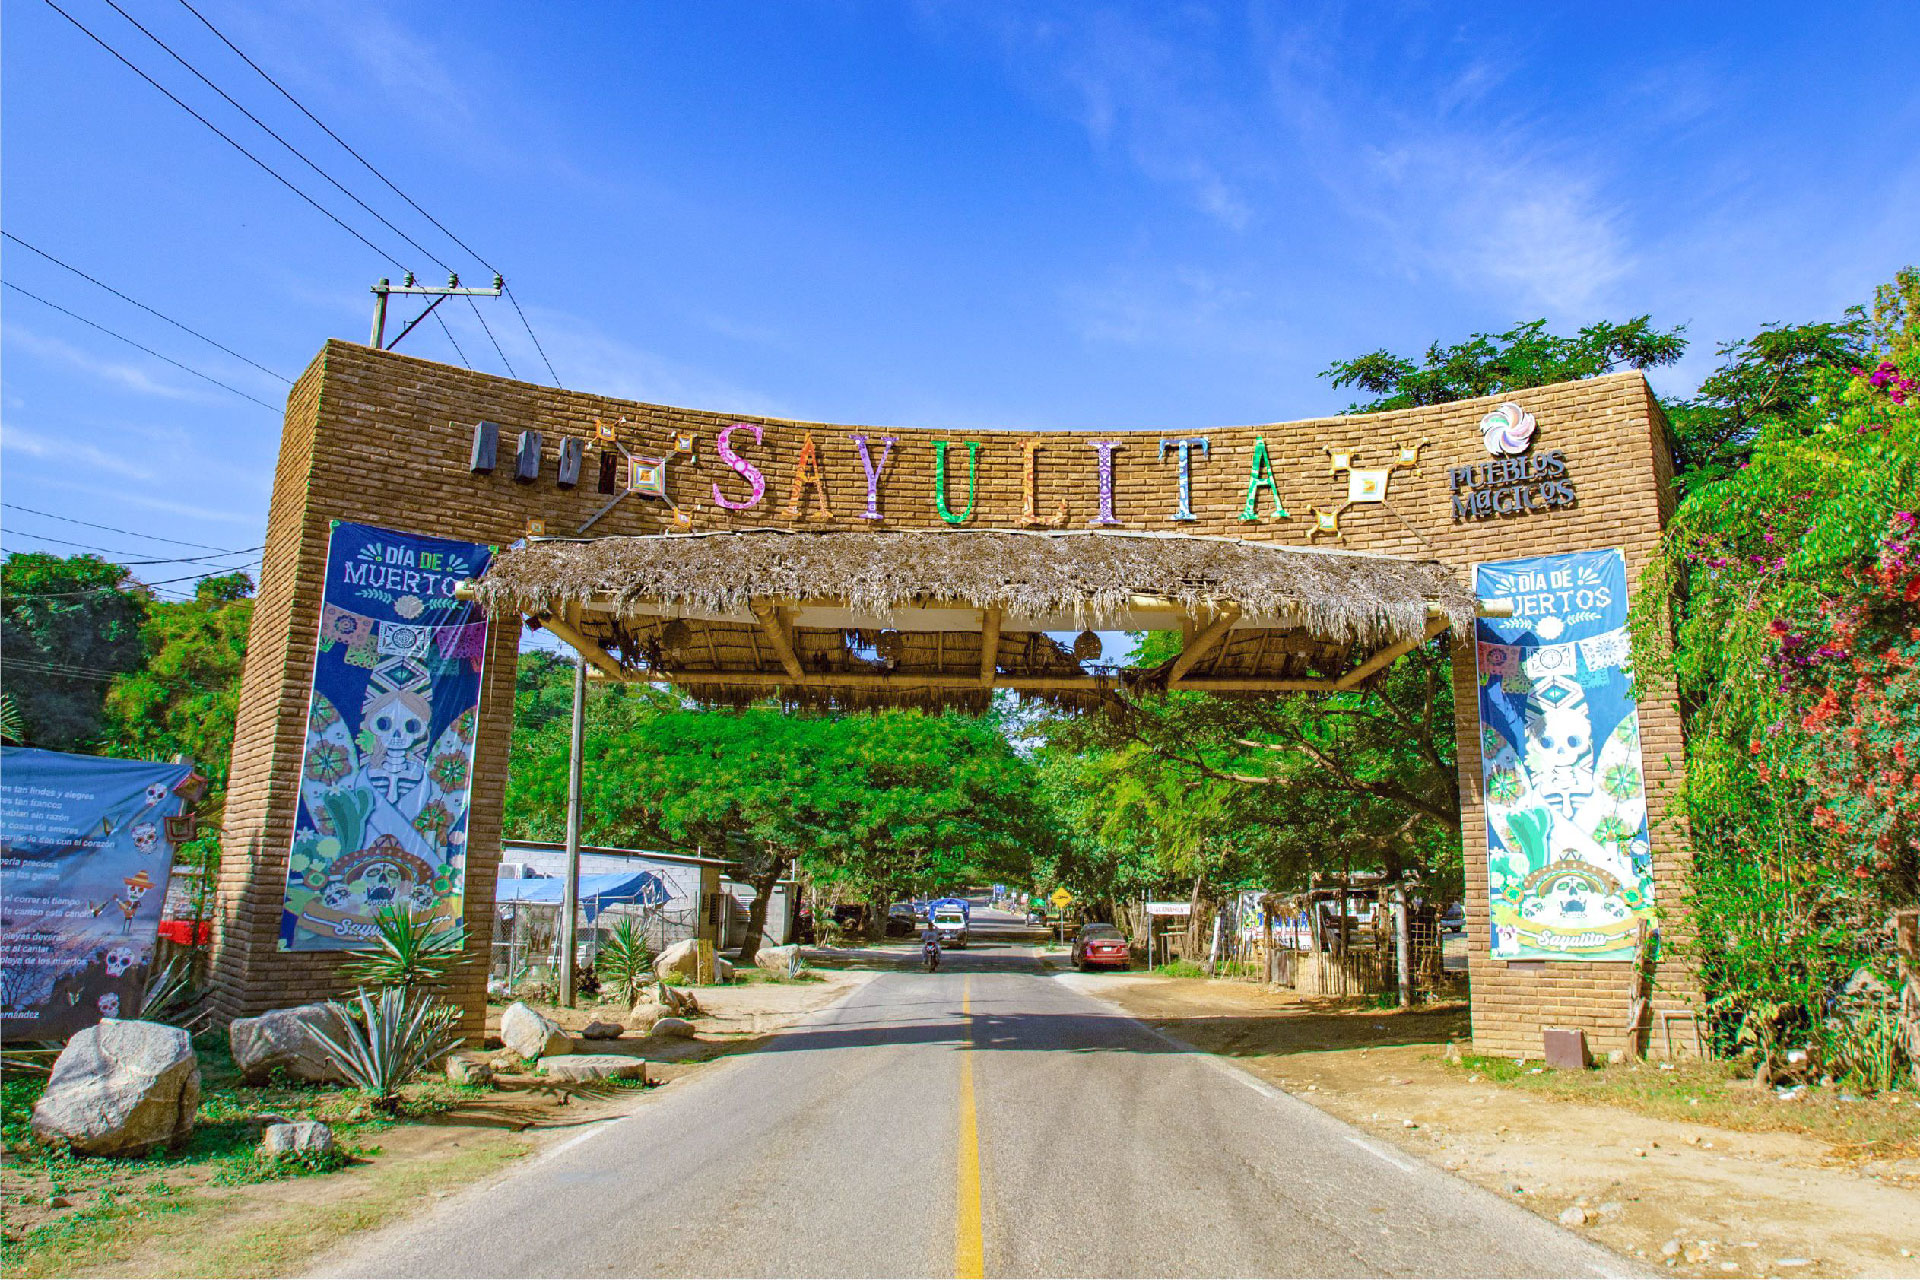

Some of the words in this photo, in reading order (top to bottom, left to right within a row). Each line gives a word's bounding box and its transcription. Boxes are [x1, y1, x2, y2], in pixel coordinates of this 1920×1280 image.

[712, 423, 1291, 524] SAYULITA
[386, 545, 415, 568] DÍA
[420, 551, 444, 571] DE
[344, 561, 457, 598] MUERTO
[1519, 570, 1548, 593] DÍA
[1551, 569, 1573, 588] DE
[1507, 586, 1612, 617] UERTOS
[83, 839, 116, 848] corazón
